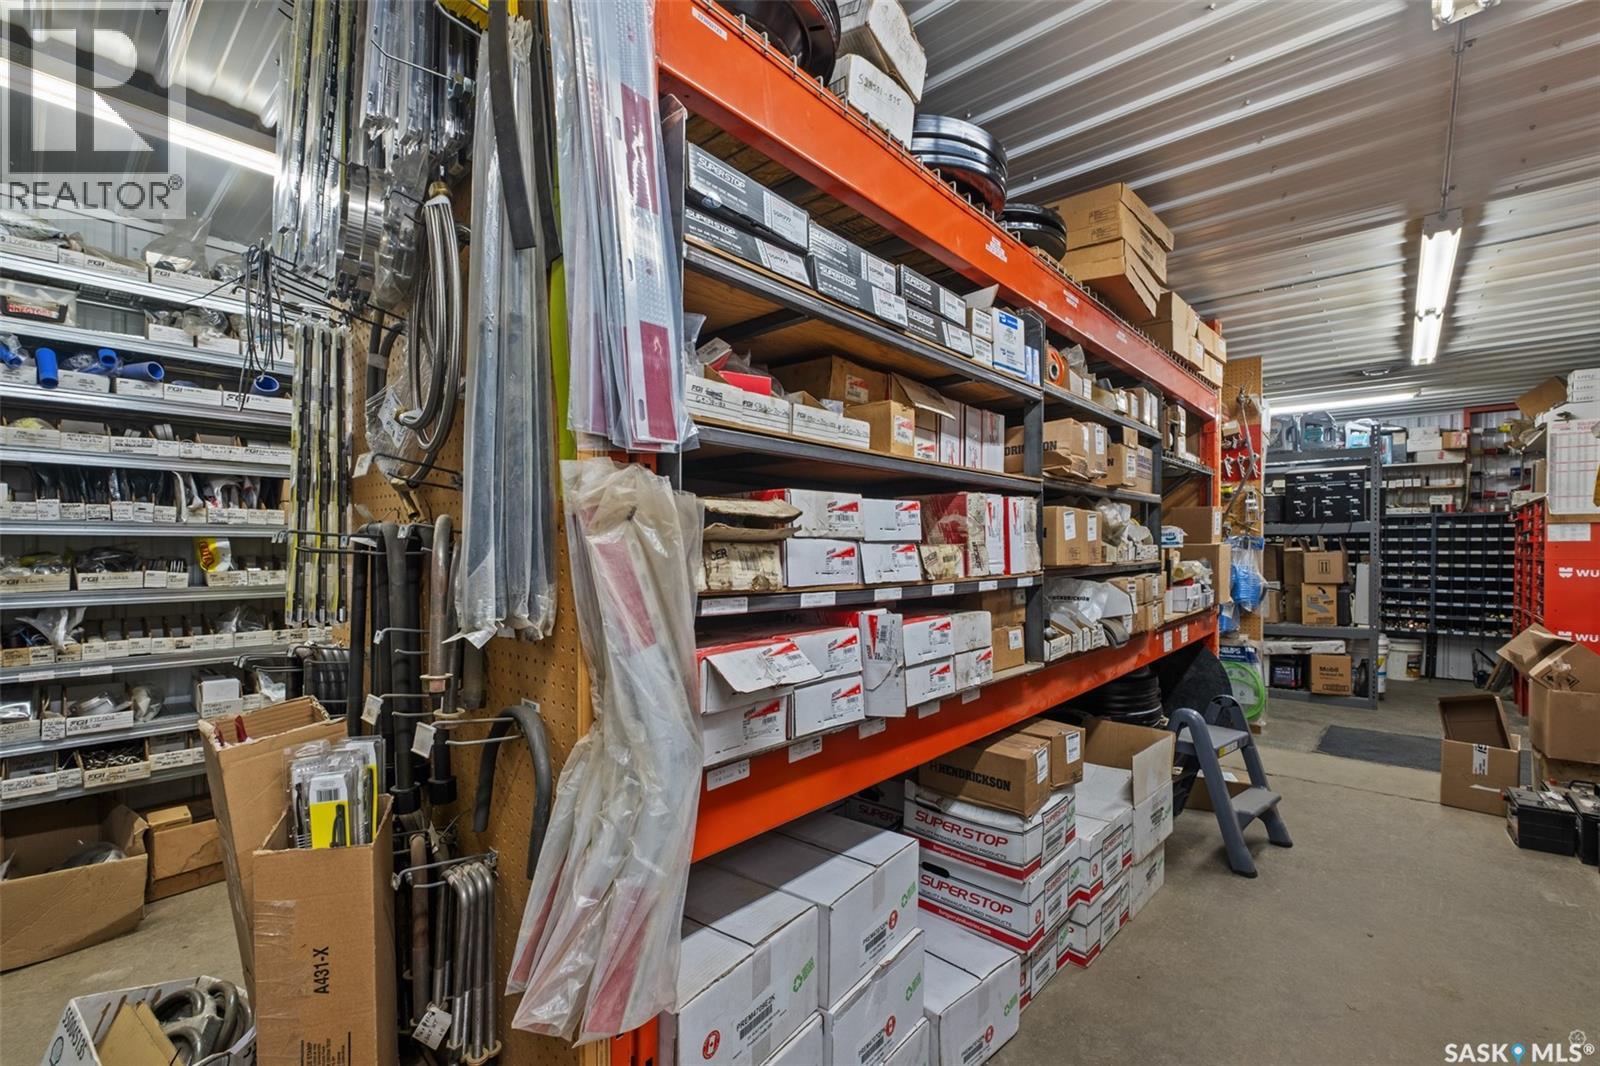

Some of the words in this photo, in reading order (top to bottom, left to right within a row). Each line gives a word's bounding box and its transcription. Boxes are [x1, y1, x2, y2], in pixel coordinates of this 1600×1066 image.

[698, 157, 746, 189] SUPERSTOP
[685, 208, 736, 235] SUPERSTOP
[937, 762, 1011, 792] HENDRICKSON
[312, 946, 330, 995] A431-X
